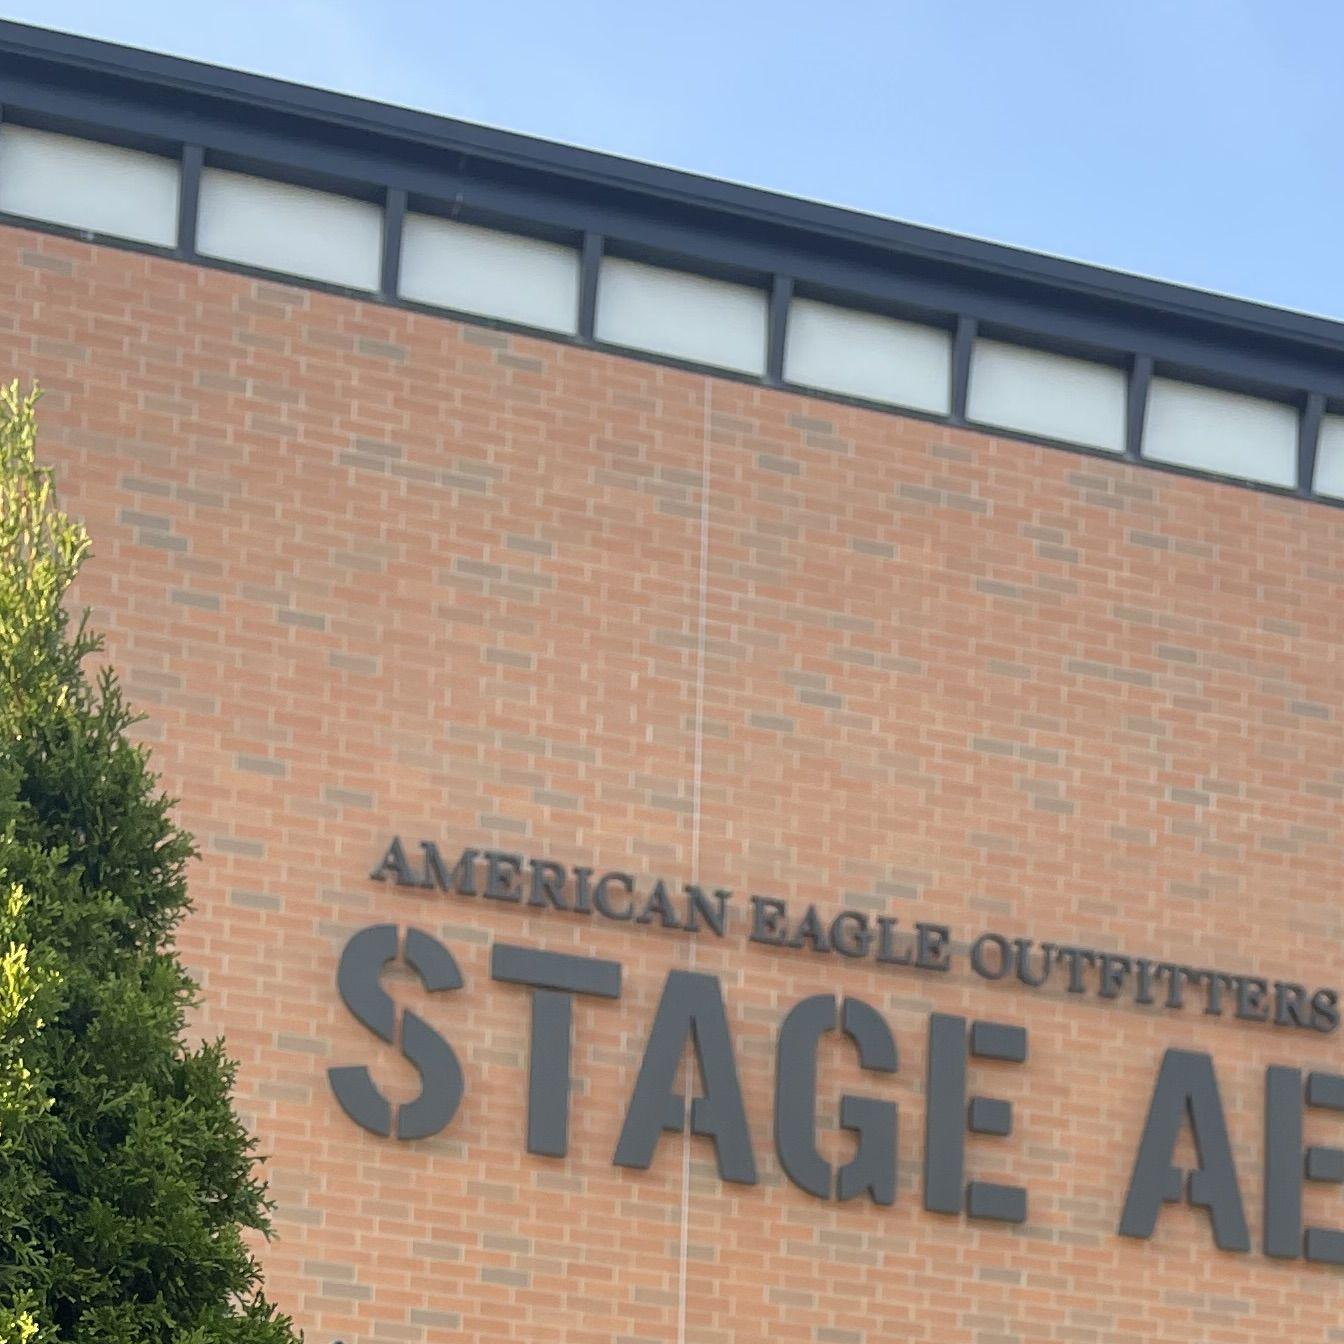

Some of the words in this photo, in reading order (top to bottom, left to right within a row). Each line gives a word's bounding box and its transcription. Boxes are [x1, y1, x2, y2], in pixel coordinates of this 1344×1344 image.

[370, 834, 733, 937] AMERICAN
[748, 895, 952, 971] EAGLE
[970, 932, 1343, 1033] OUTFITTERS
[327, 923, 1027, 1225] STAGE
